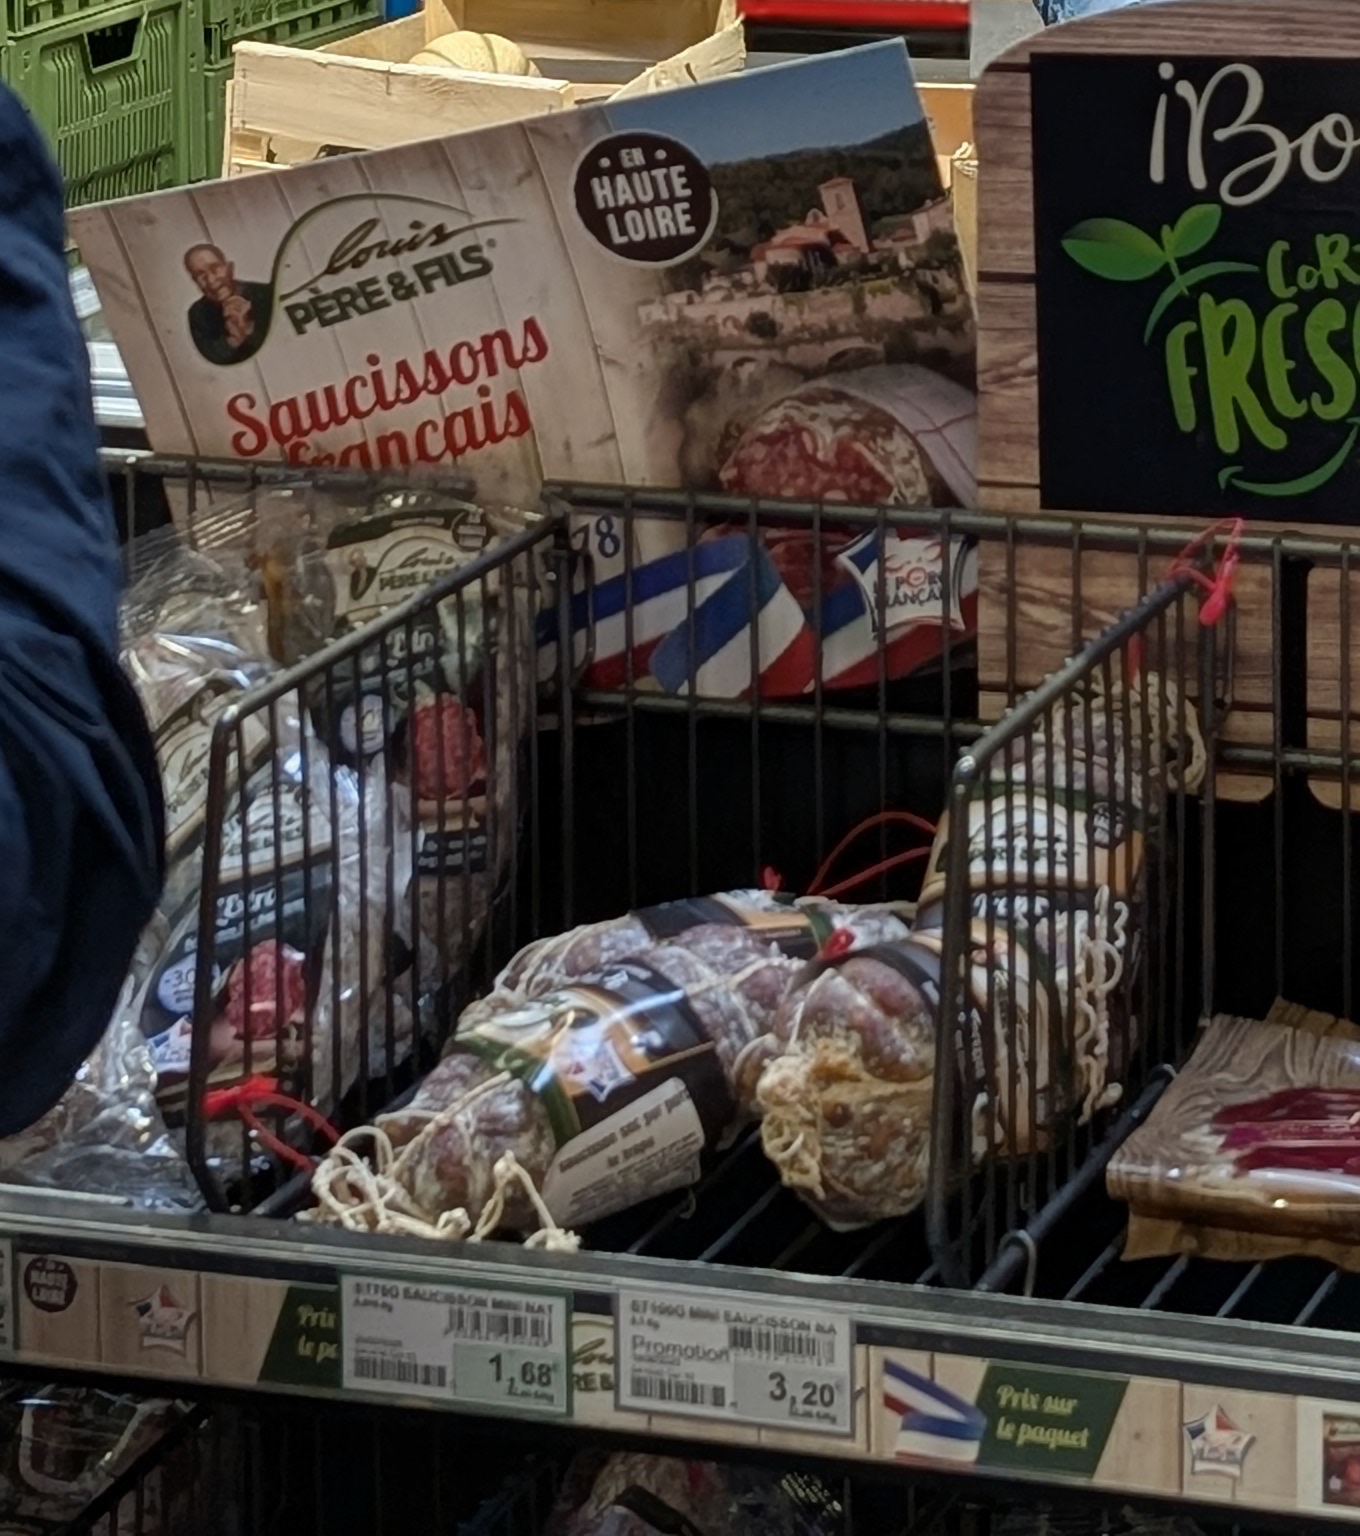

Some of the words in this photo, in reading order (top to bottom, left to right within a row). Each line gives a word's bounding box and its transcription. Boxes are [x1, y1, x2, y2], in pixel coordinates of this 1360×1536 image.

[591, 165, 693, 213] HAUTE
[606, 200, 696, 245] LOIRE
[412, 243, 495, 294] FILS
[226, 315, 550, 457] Saucissons
[723, 1309, 812, 1333] SAUCISSON
[631, 1333, 731, 1363] Promotion
[768, 1371, 836, 1412] 3,20
[996, 1384, 1039, 1412] Prix
[1041, 1394, 1078, 1415] sur
[996, 1417, 1016, 1439] le
[1018, 1421, 1090, 1450] paquet
